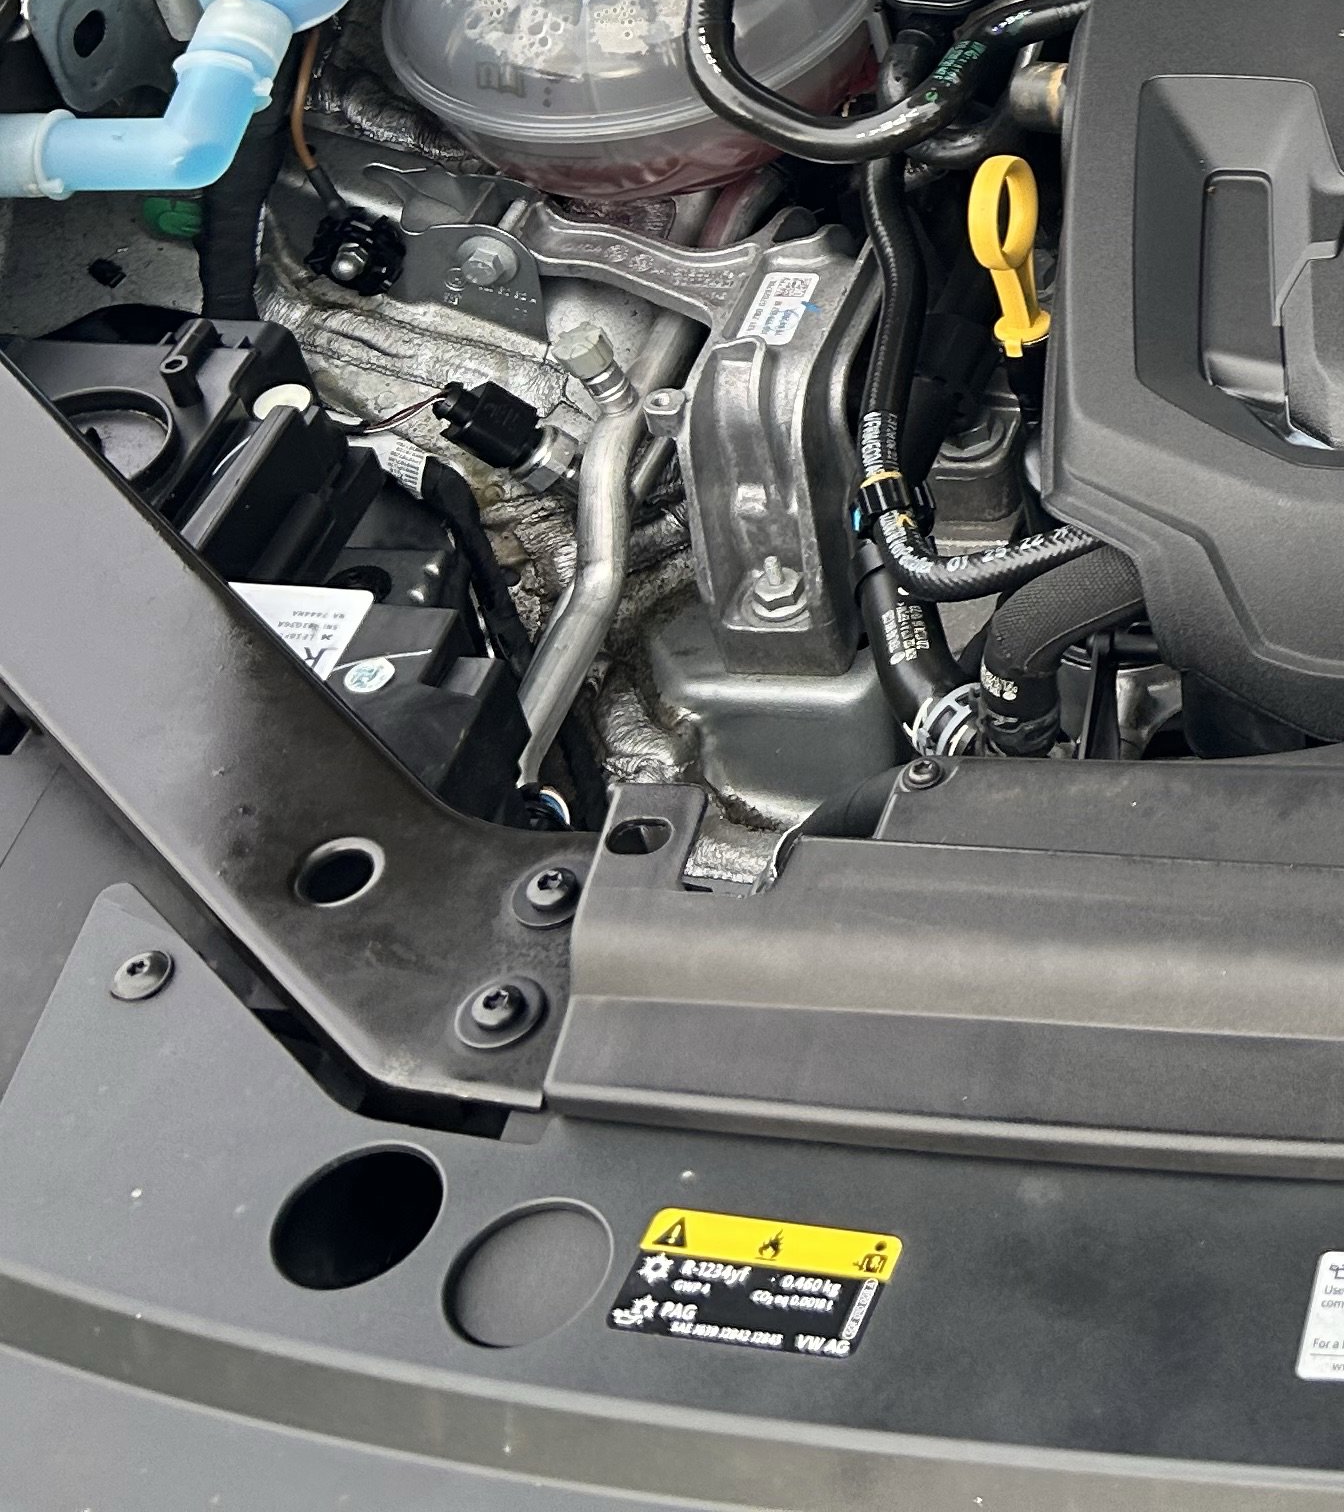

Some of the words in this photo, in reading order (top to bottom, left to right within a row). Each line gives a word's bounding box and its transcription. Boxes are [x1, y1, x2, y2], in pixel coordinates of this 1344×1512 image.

[678, 1261, 752, 1285] R-1234yf
[781, 1274, 822, 1292] 0.460
[821, 1280, 841, 1297] kg
[1324, 1285, 1344, 1295] Use
[659, 1301, 698, 1319] PAG
[795, 1334, 826, 1351] VW
[827, 1338, 851, 1356] AG
[1313, 1338, 1330, 1349] For
[1332, 1340, 1339, 1350] a
